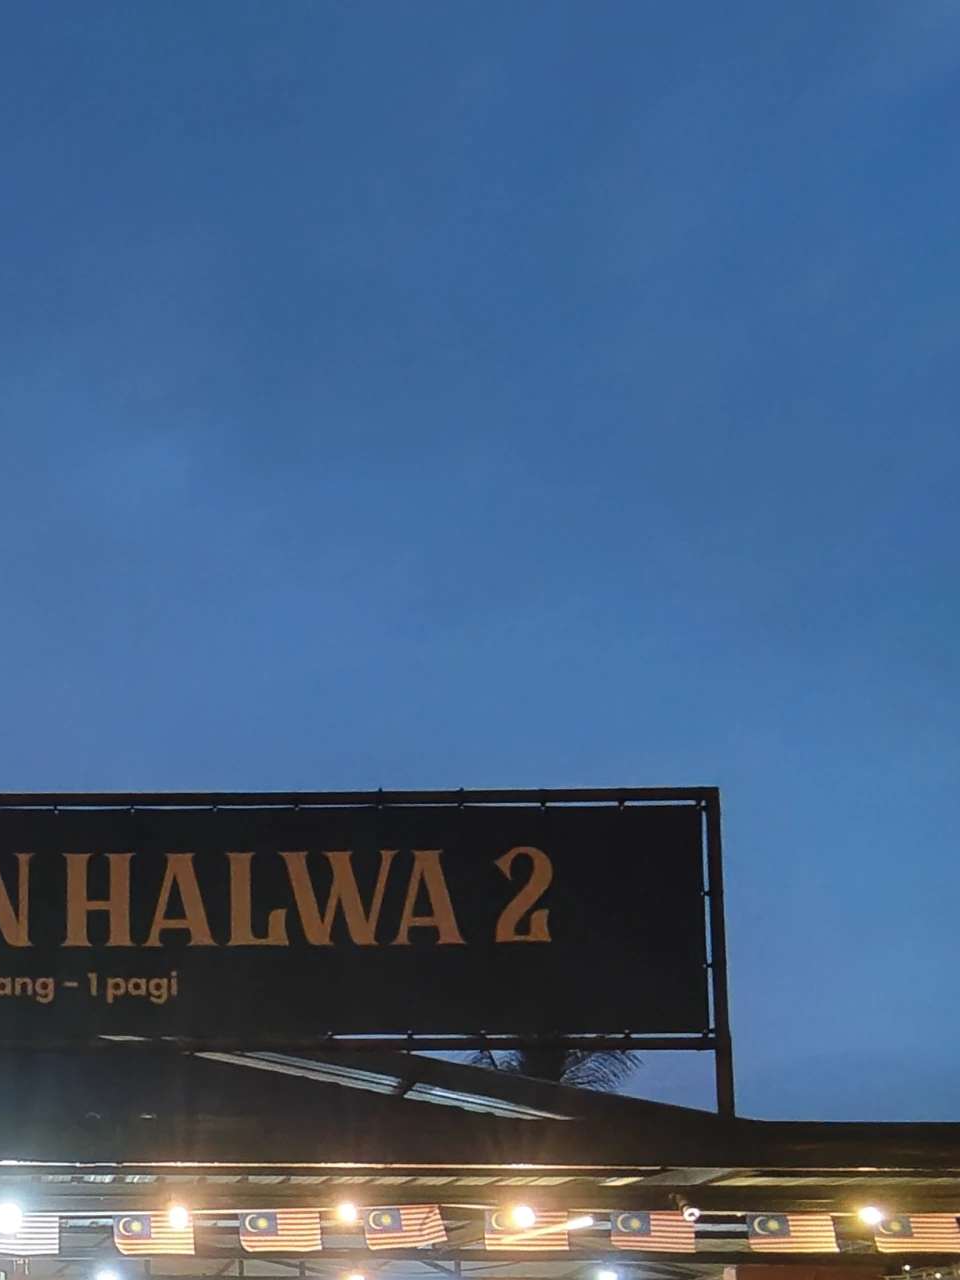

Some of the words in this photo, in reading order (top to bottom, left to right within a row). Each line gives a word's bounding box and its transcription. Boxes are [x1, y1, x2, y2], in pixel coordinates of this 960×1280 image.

[60, 848, 468, 948] HALWA
[493, 846, 553, 943] 2
[87, 972, 98, 996] 1
[105, 970, 179, 1004] pagi
